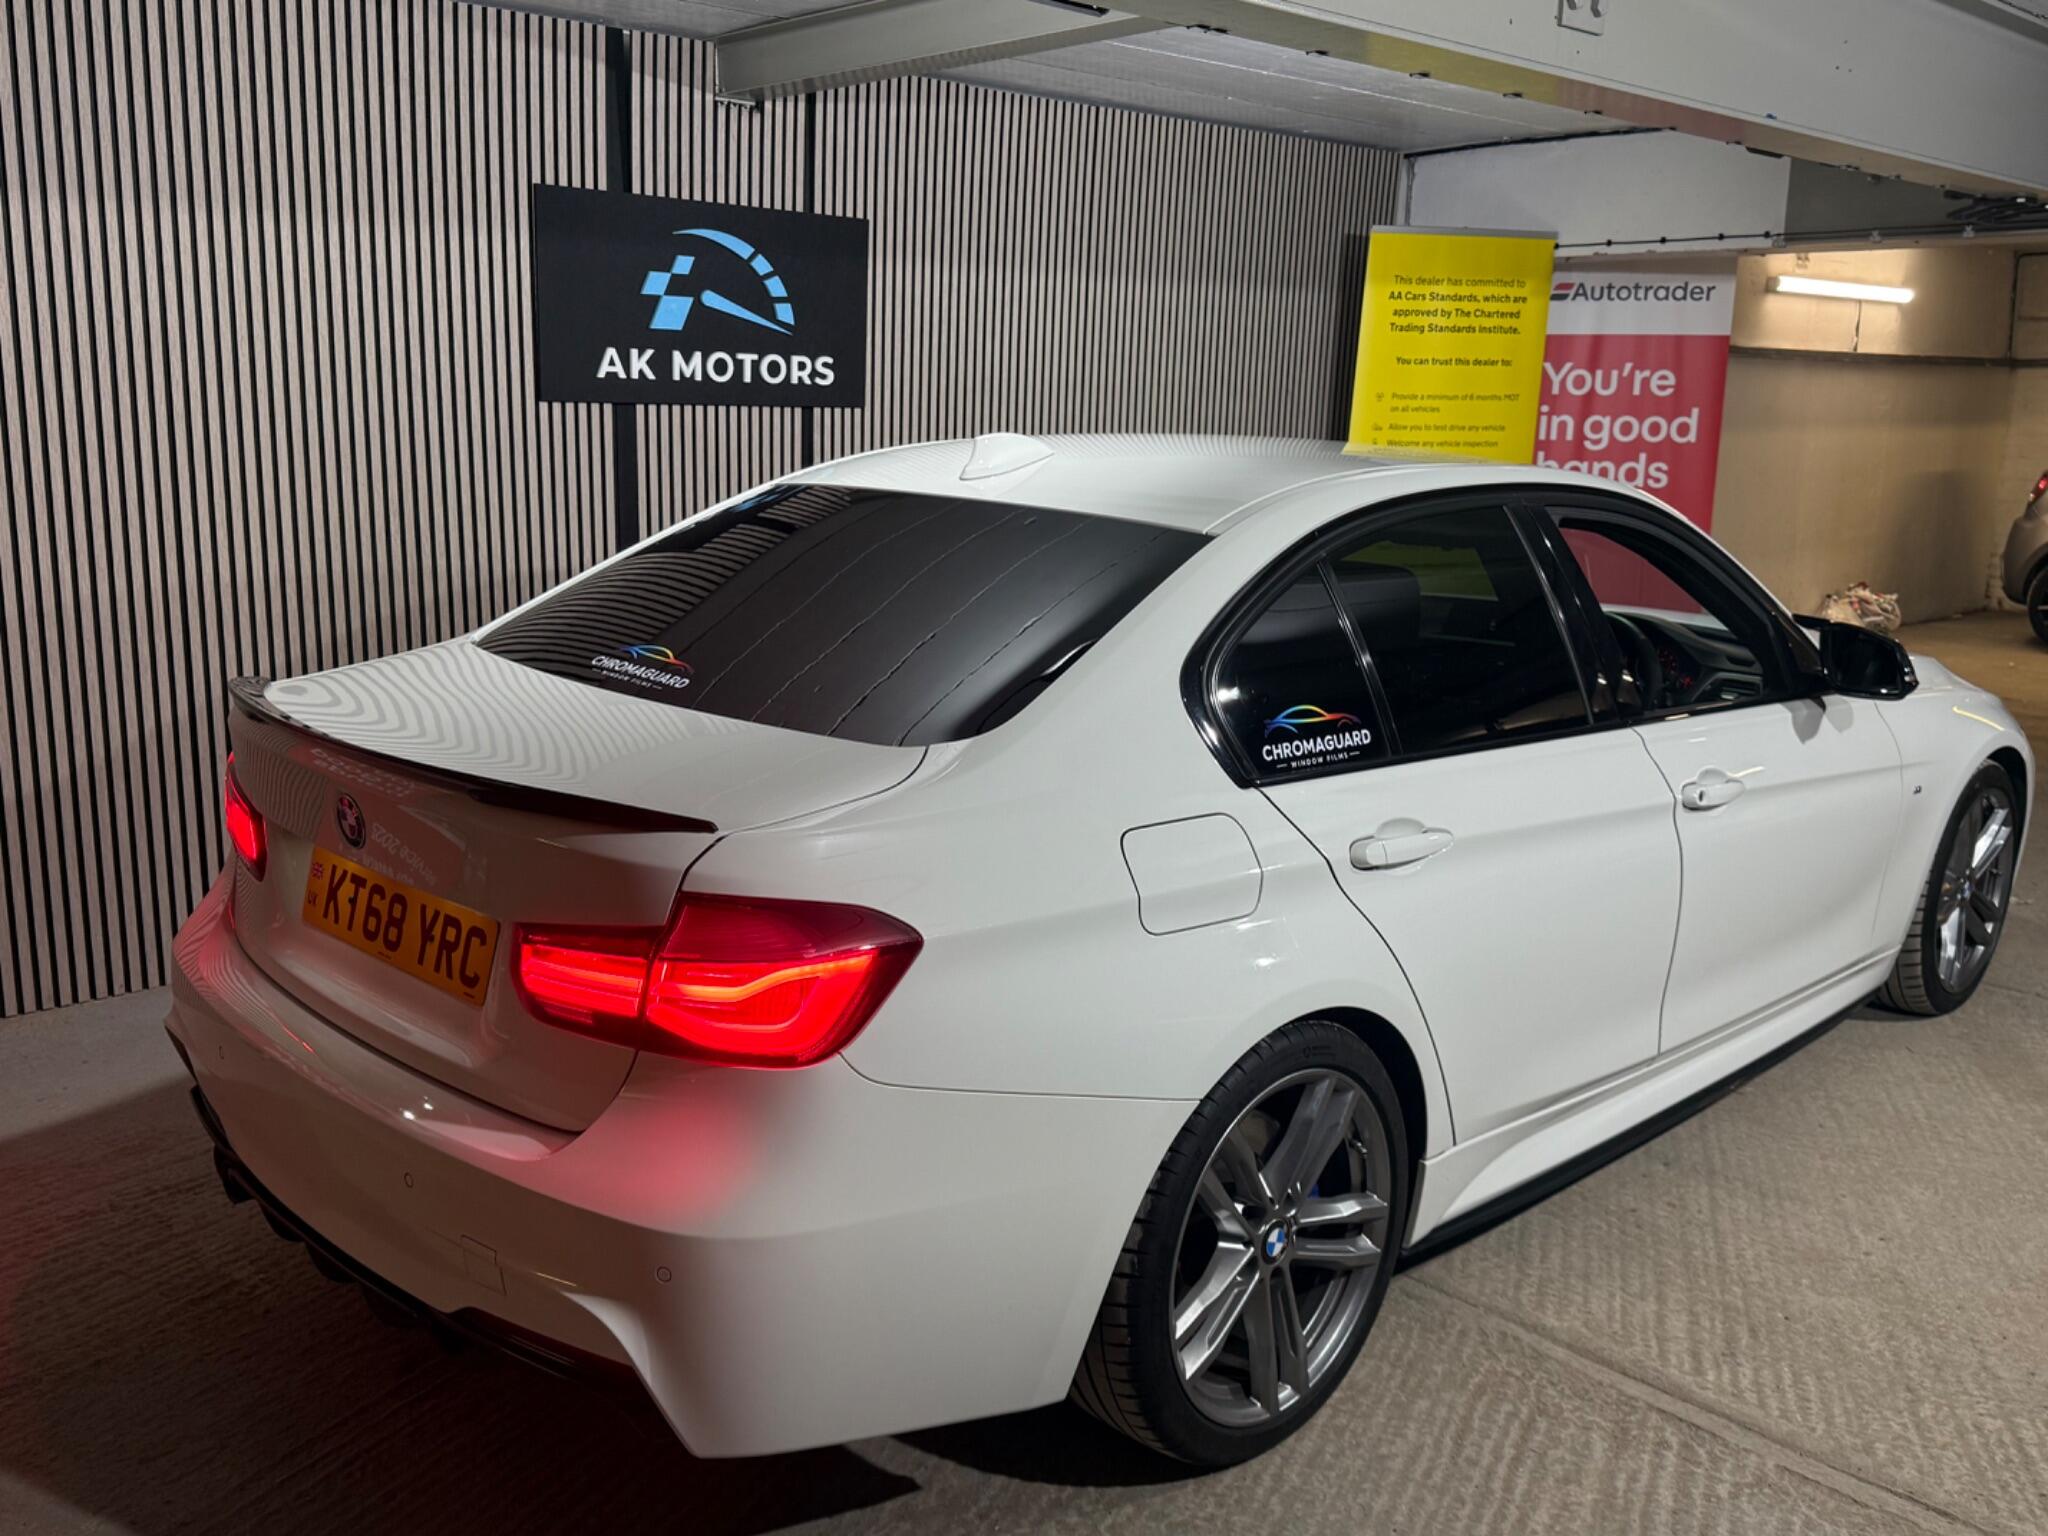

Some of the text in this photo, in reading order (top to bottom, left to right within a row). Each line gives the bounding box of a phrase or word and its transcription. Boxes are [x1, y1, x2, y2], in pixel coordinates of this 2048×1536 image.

[1394, 275, 1526, 288] This dealer has committed to
[1388, 291, 1528, 304] AA Cars Standards, which are
[1571, 282, 1716, 301] Autotrader
[1392, 308, 1521, 320] approved by The Chartered
[1390, 323, 1521, 335] Trading Standards Institute.
[597, 346, 835, 386] AK MOTORS
[1396, 356, 1512, 367] You can trust this dealer to:
[1543, 362, 1677, 396] You're
[1392, 392, 1418, 401] Provide
[1426, 393, 1460, 401] minimum
[1476, 393, 1501, 402] months
[1503, 393, 1520, 402] MOT
[1411, 405, 1440, 414] vehicles
[1388, 423, 1408, 432] Allow
[1409, 425, 1422, 433] you
[1433, 424, 1446, 432] test
[1448, 424, 1465, 432] drive
[1467, 425, 1479, 433] any
[1480, 424, 1505, 433] vehicle
[1538, 404, 1699, 451] in good
[1386, 439, 1498, 449] Welcome any vehicle inspection
[591, 655, 690, 689] CHROMAGUARD
[1262, 729, 1371, 762] CHROMAGUARD
[1291, 751, 1348, 768] WINDOW FILMS
[322, 863, 487, 989] KT68 YRC
